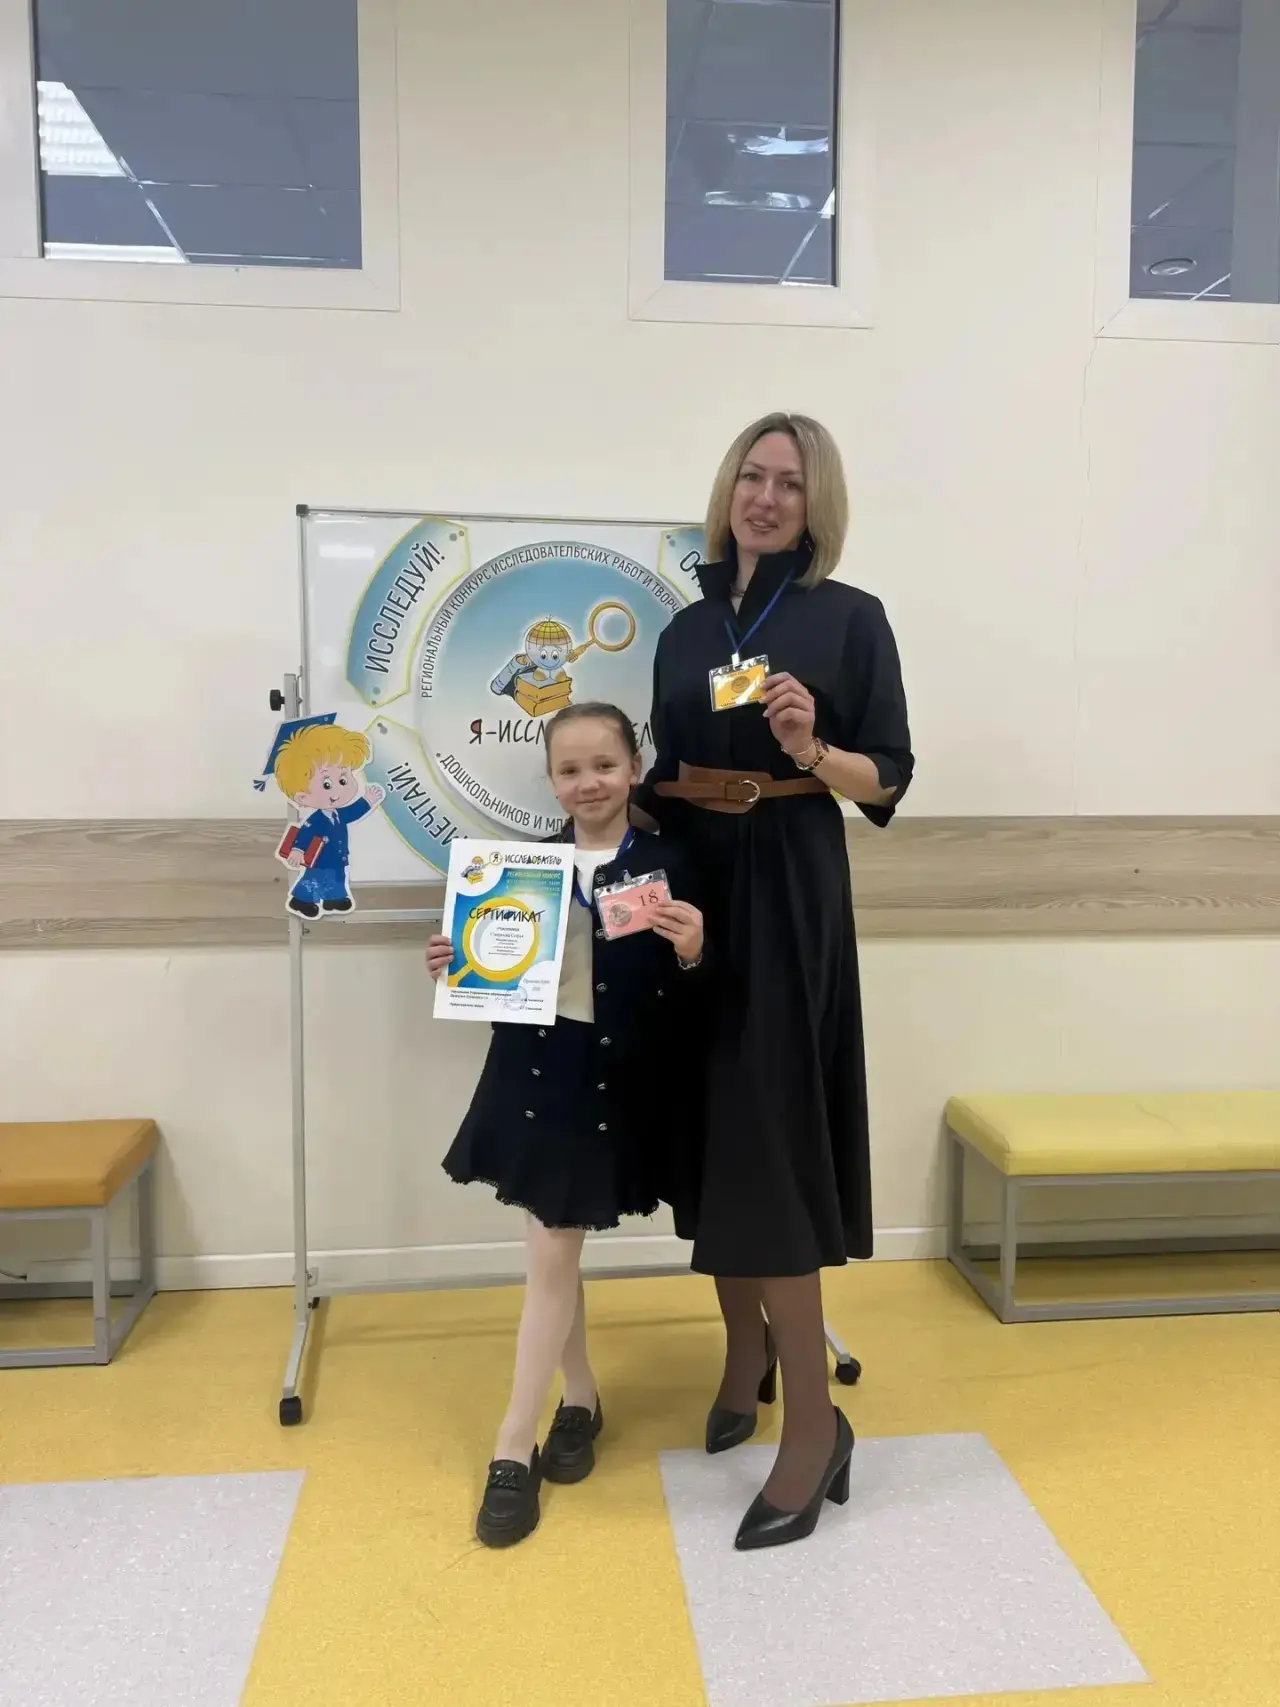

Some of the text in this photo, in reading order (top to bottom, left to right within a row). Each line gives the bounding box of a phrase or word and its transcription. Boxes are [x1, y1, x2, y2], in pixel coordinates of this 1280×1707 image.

[365, 541, 445, 674] ИССЛЕДУЙ!
[421, 608, 454, 698] РЕГИОНАЛЬНЫЙ
[452, 568, 492, 612] КОНКУРС
[491, 545, 610, 574] ИССЛЕДОВАТЕЛЬСКИХ
[612, 556, 644, 581] РАБОТ
[642, 575, 653, 588] И
[440, 753, 565, 832] ДОШКОЛЬНИКОВ И МЛ
[493, 853, 562, 866] Я ИССЛЕДОВАТЕЛЬ
[468, 907, 546, 923] СЕРТИФИКАТ
[638, 889, 659, 907] 18
